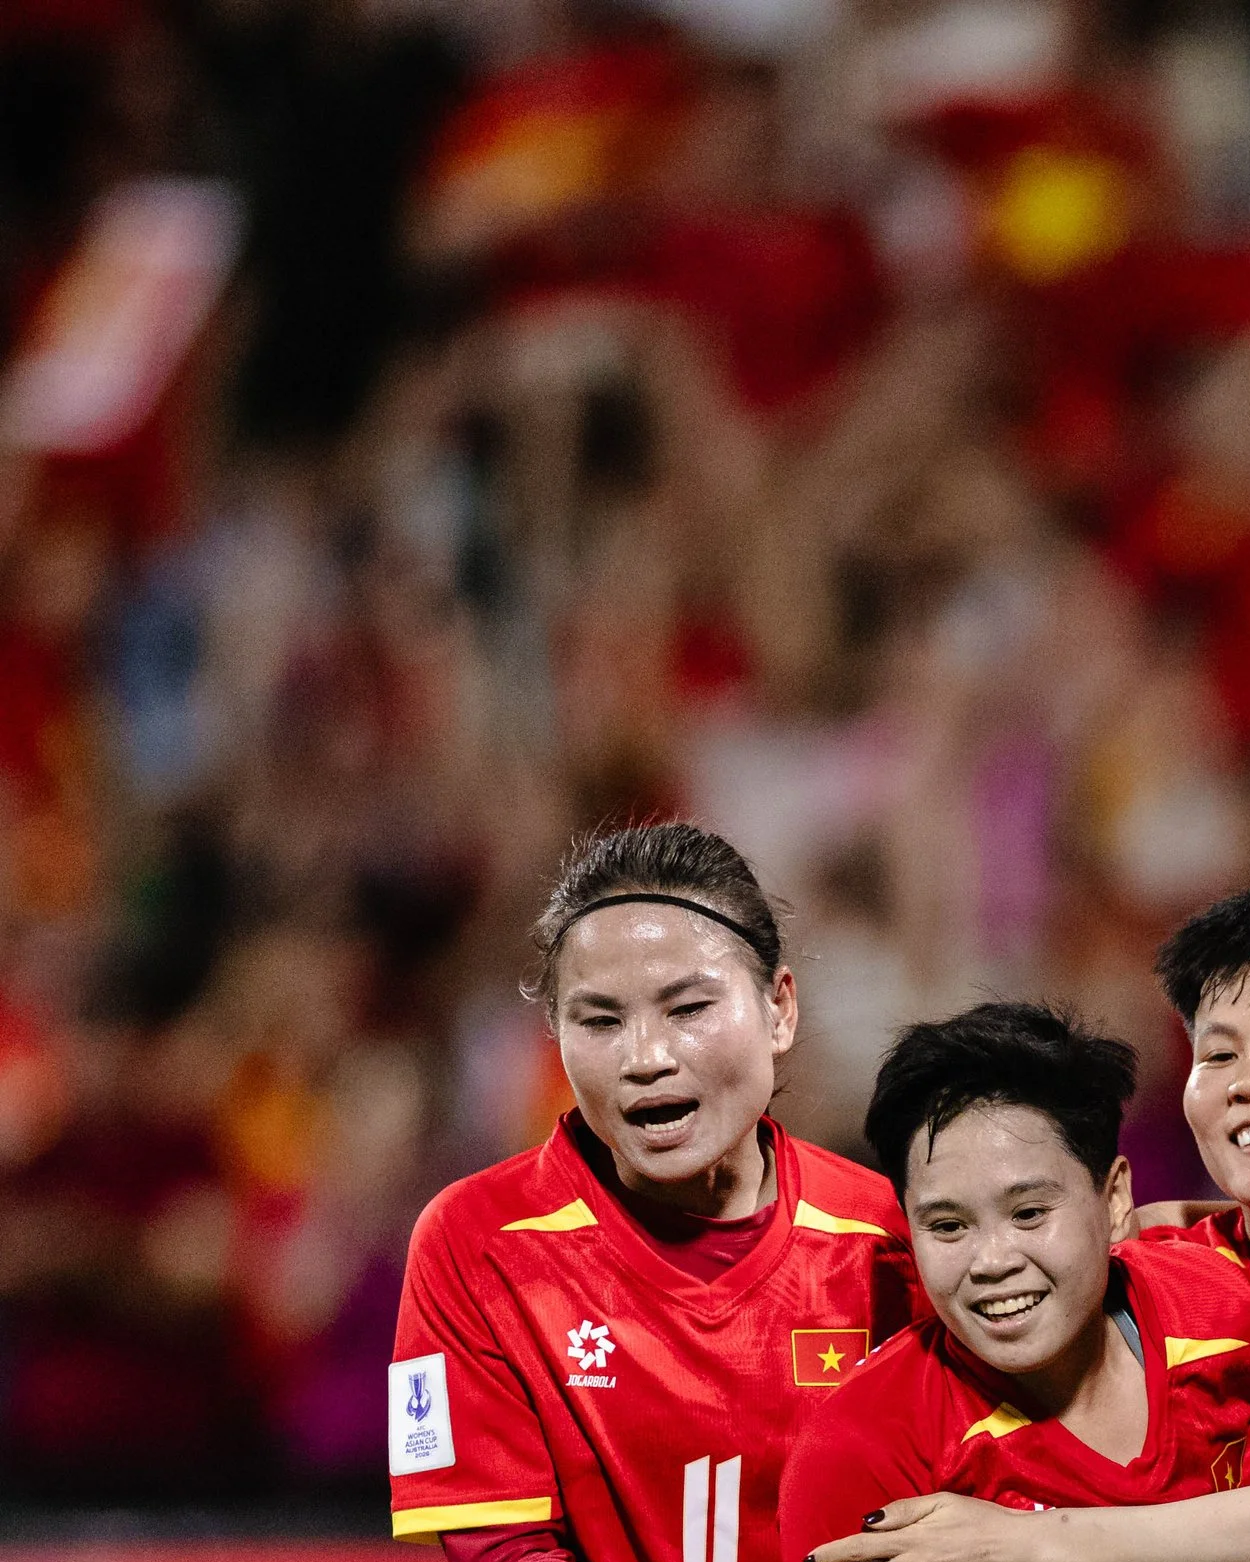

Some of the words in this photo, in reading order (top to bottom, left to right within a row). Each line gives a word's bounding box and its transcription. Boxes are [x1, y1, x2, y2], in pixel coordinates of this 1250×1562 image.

[565, 1374, 617, 1389] JOGARBOLA
[407, 1429, 436, 1440] WOMEN'S
[404, 1437, 424, 1449] ASIAN
[424, 1435, 438, 1445] CUP
[405, 1443, 438, 1454] AUSTRALIA
